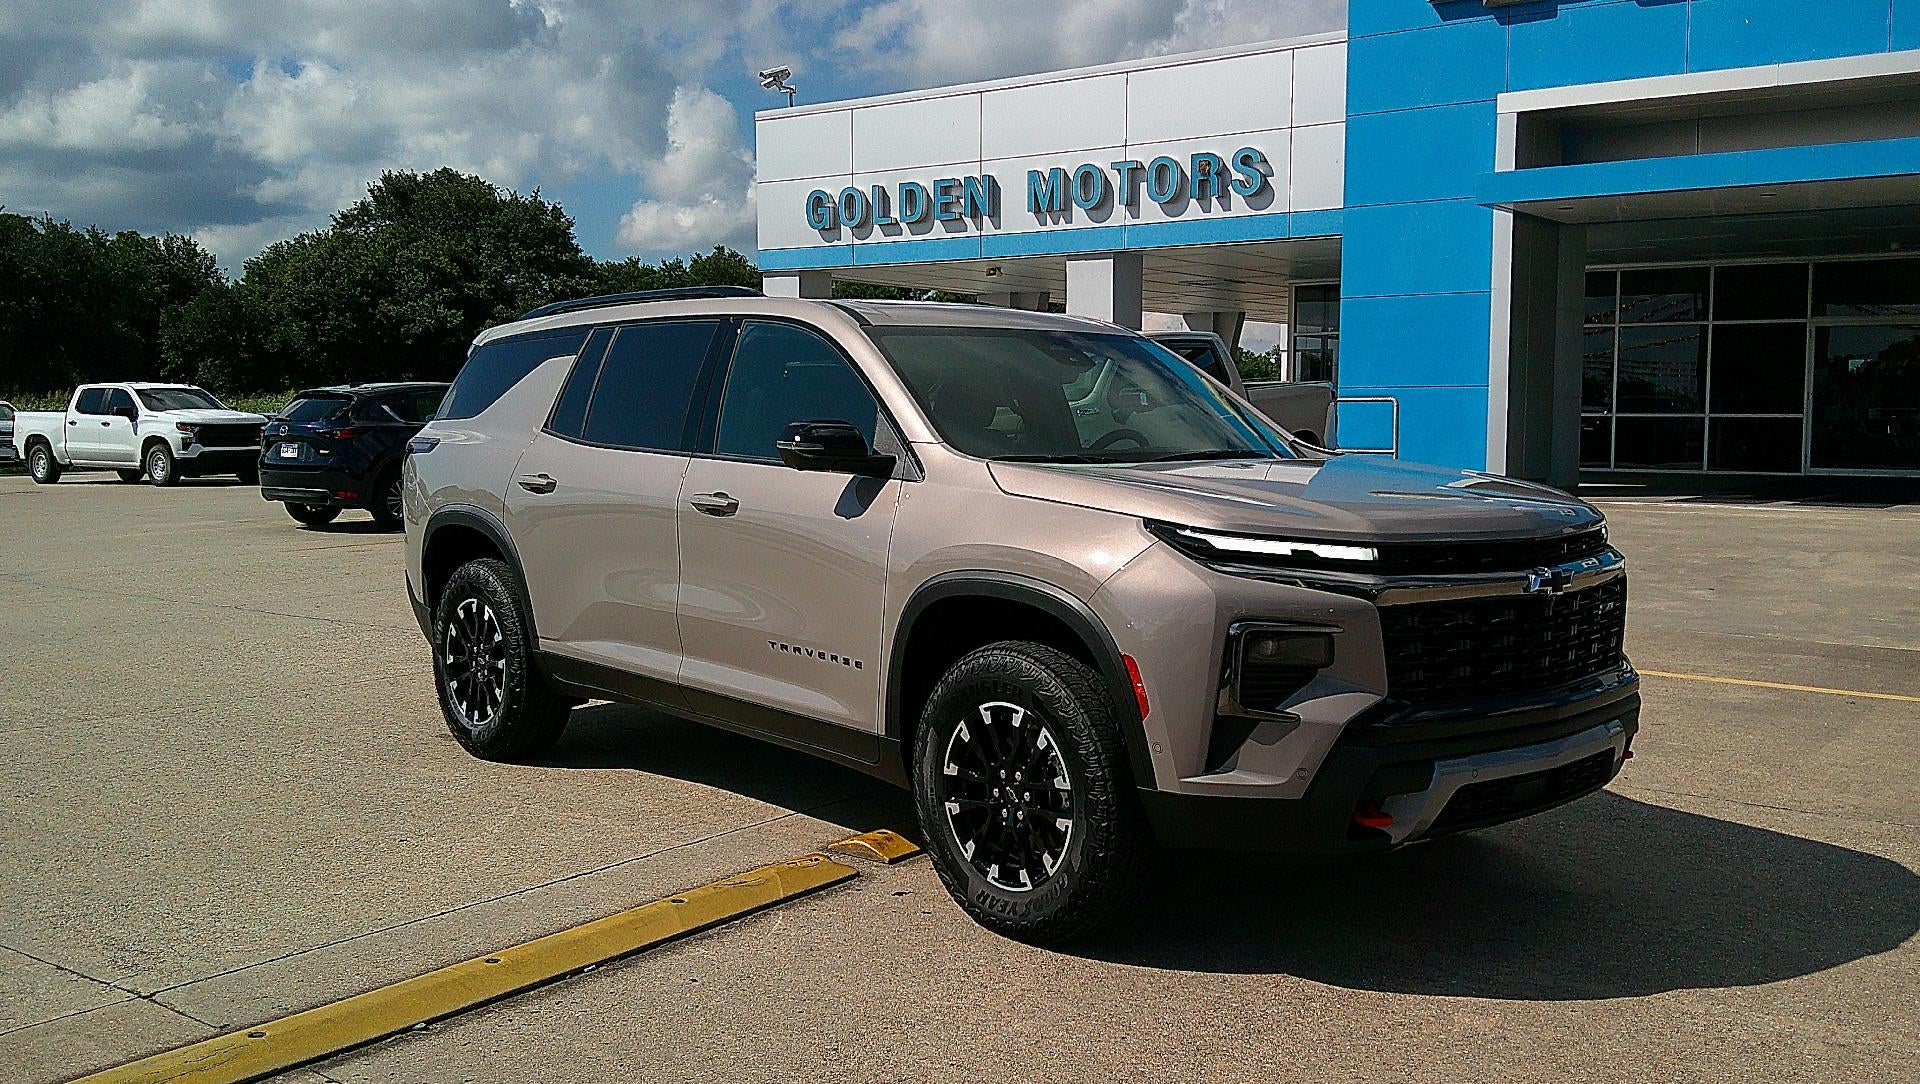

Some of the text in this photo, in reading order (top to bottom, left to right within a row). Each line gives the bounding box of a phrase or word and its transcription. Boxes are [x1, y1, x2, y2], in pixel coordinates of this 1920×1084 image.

[805, 147, 1268, 232] GOLDEN MOTORS
[767, 640, 864, 670] TRAVERSE
